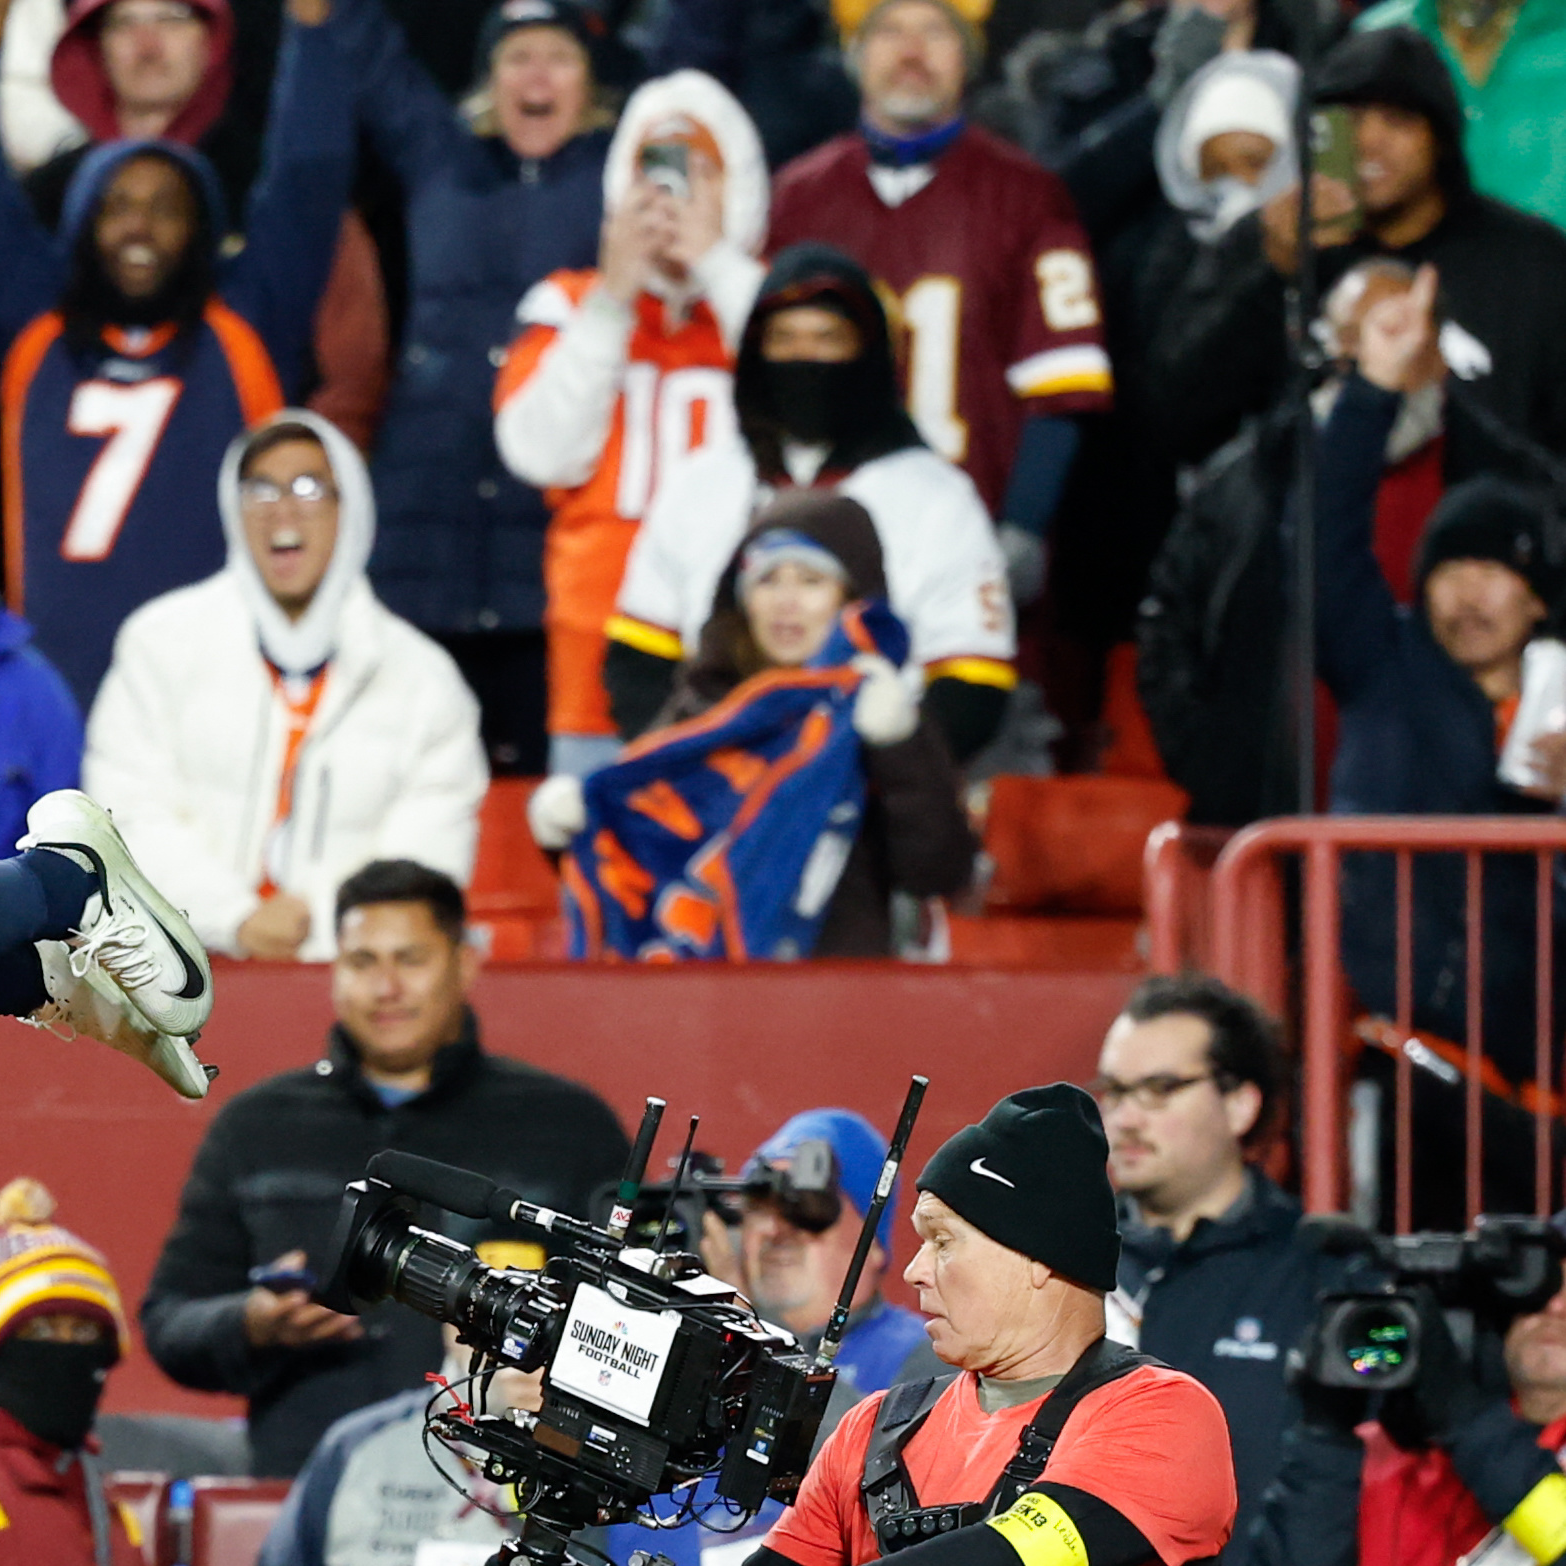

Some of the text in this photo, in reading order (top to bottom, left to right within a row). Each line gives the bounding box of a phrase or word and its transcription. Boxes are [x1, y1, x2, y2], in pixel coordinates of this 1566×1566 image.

[61, 375, 184, 563] 7
[571, 1319, 660, 1373] SUNDAY NIGHT
[578, 1344, 641, 1380] FOOTBALL
[1030, 1512, 1047, 1527] 13
